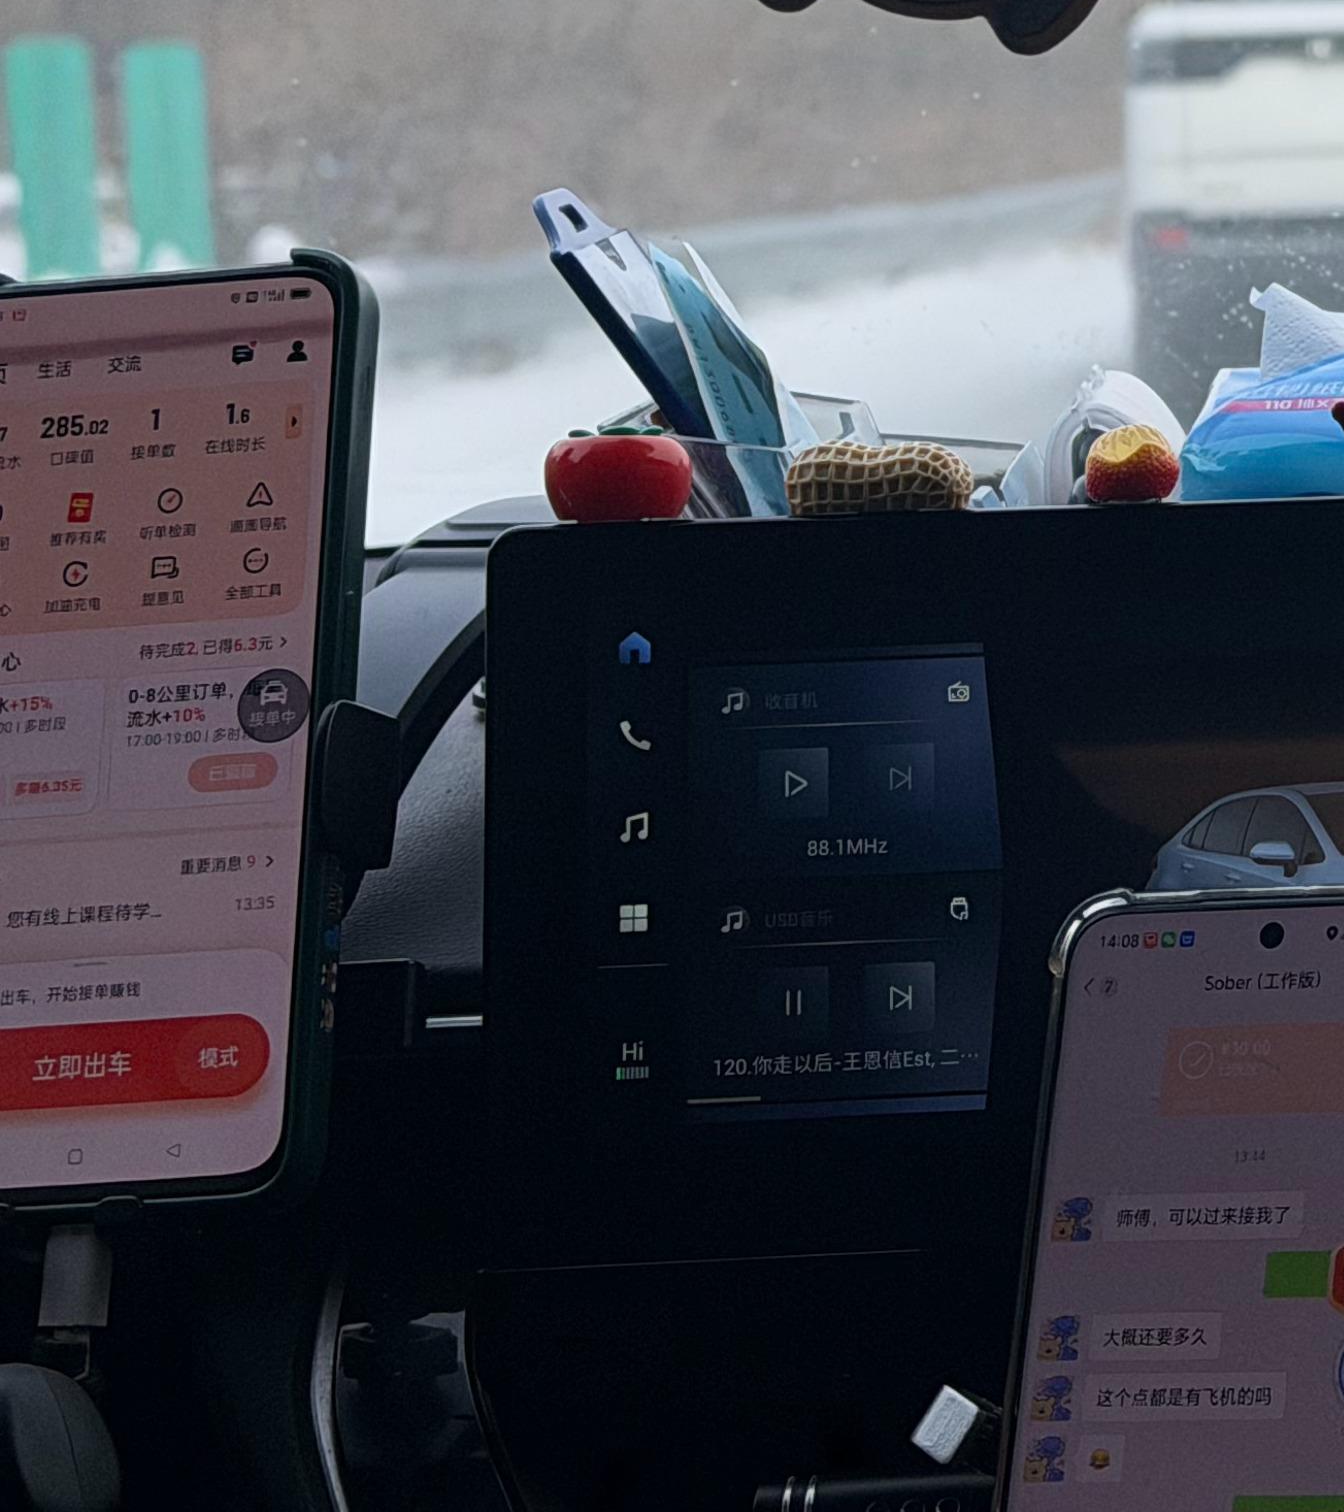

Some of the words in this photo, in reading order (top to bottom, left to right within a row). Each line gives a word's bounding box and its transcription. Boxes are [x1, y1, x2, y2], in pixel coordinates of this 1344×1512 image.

[37, 360, 71, 379] 生活
[107, 355, 142, 374] 交流
[40, 414, 109, 439] 285.02
[151, 408, 160, 430] 1
[130, 443, 176, 460] 接单数
[205, 437, 266, 455] 在线时长
[225, 583, 282, 601] 全部工具
[2, 652, 21, 672] 心
[127, 707, 206, 728] 流水+10%
[249, 710, 296, 727] 接单中
[806, 837, 889, 858] 88.1MHz
[181, 857, 241, 875] 重要消息
[235, 895, 275, 911] 13:35
[1100, 932, 1139, 950] 14:08
[1204, 974, 1253, 992] Sober
[198, 1046, 239, 1069] 模式
[622, 1040, 645, 1062] Hi
[32, 1051, 132, 1081] 立即出车
[1116, 1206, 1291, 1229] 师傅，可以过来接我了
[1104, 1326, 1208, 1350] 大概还要多久
[1097, 1386, 1272, 1409] 这个点都是有飞机的吗
